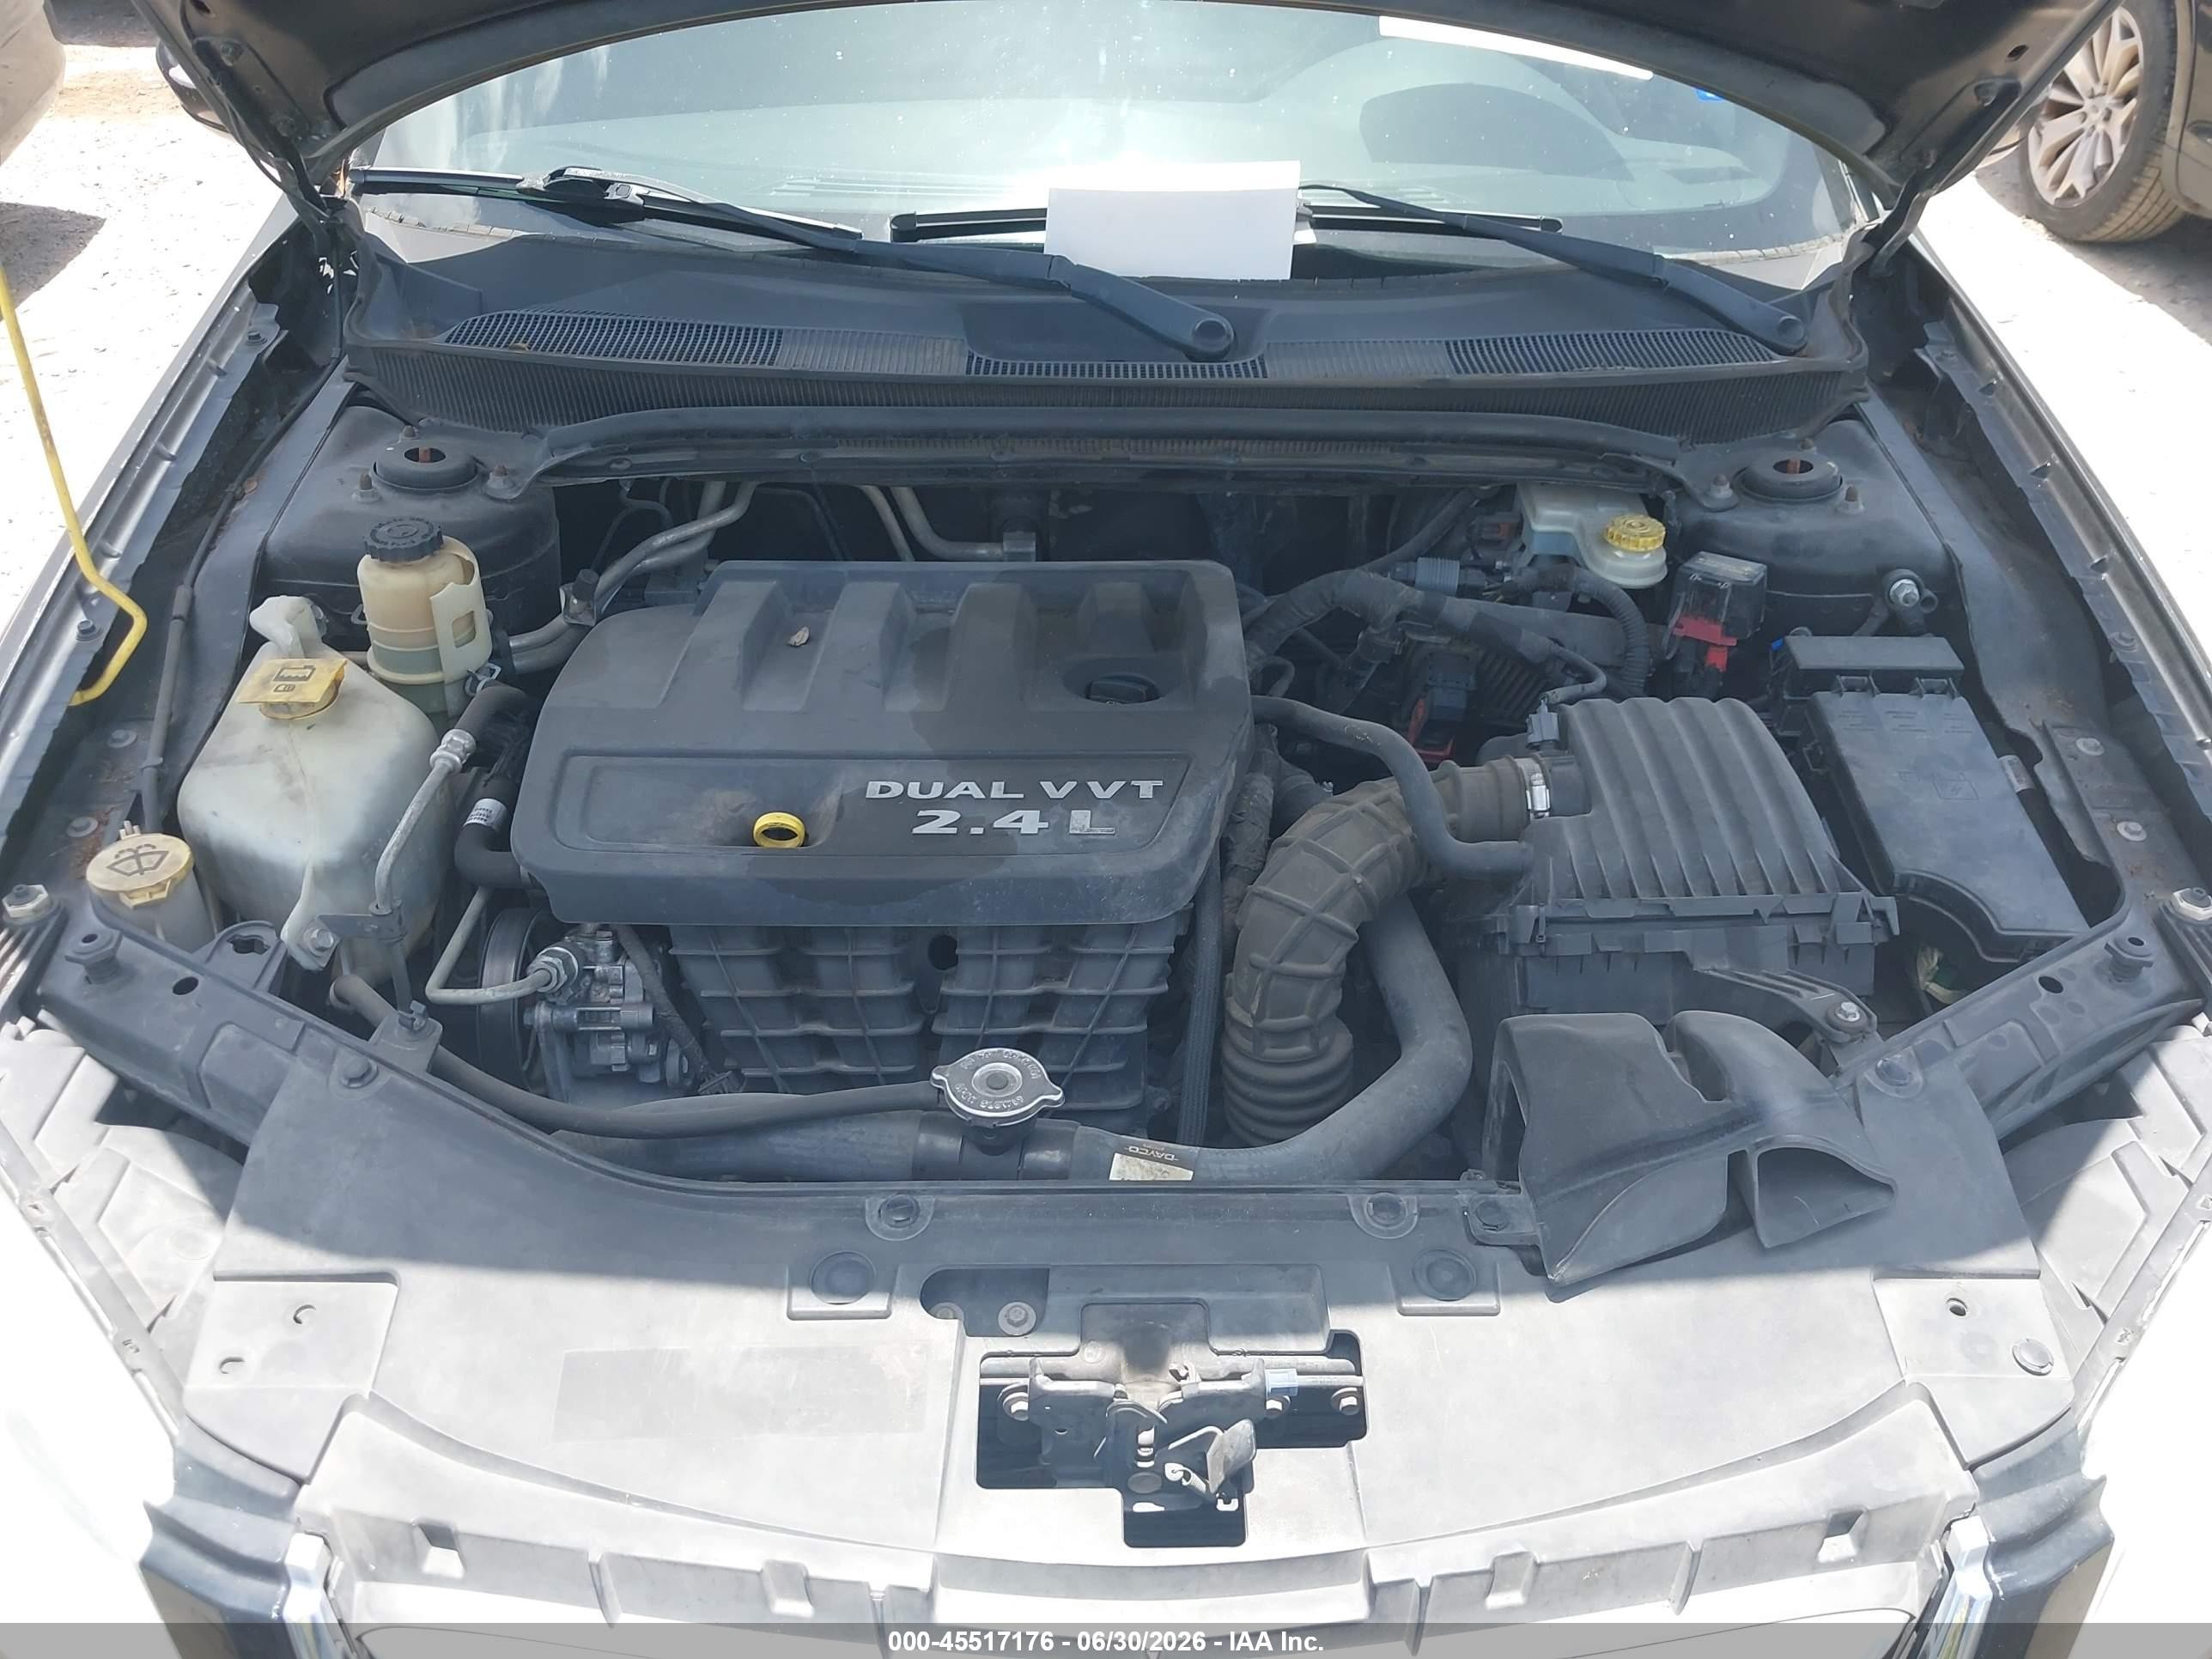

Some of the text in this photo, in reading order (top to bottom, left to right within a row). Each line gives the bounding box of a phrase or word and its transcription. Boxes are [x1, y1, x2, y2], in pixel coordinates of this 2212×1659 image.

[865, 780, 1164, 799] DUAL VVT
[1127, 1146, 1176, 1161] DAYCO
